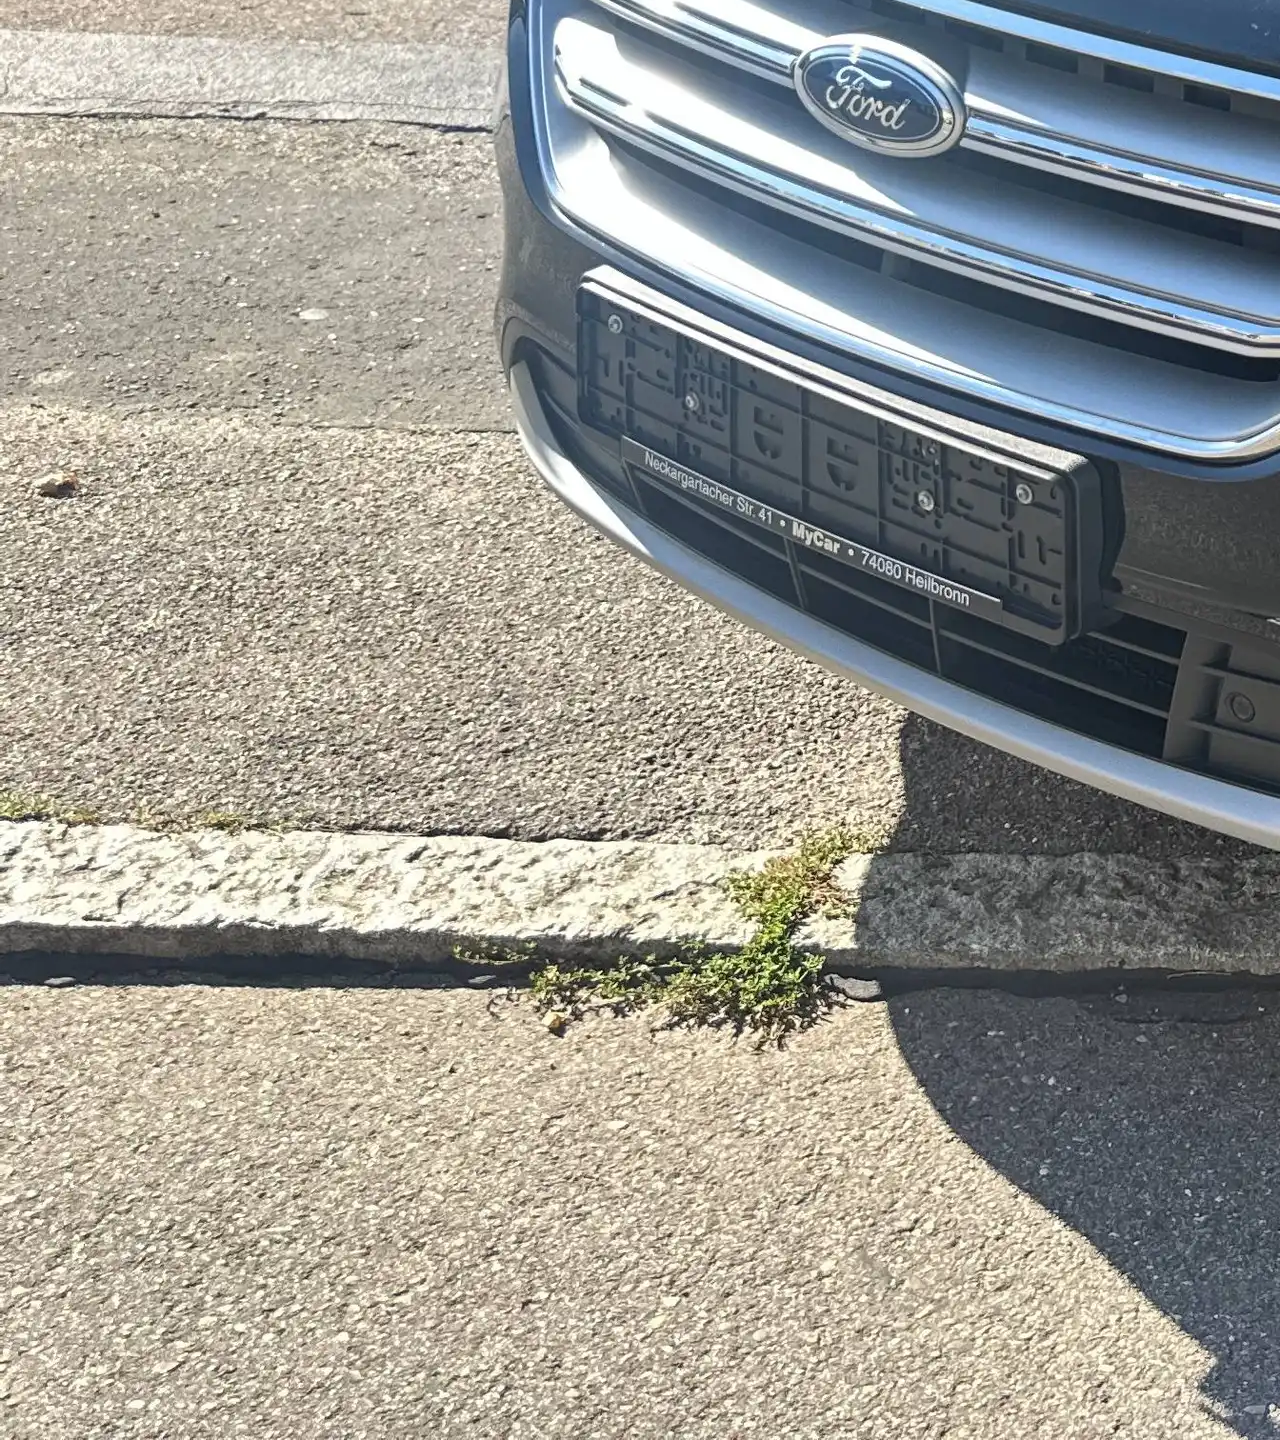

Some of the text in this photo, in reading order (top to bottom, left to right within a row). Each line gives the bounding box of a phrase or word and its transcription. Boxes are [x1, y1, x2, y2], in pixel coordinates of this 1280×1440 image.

[826, 64, 911, 130] Ford
[644, 450, 970, 606] Neckargartacher Str. 41 MyCar 74080 Heilbronn
